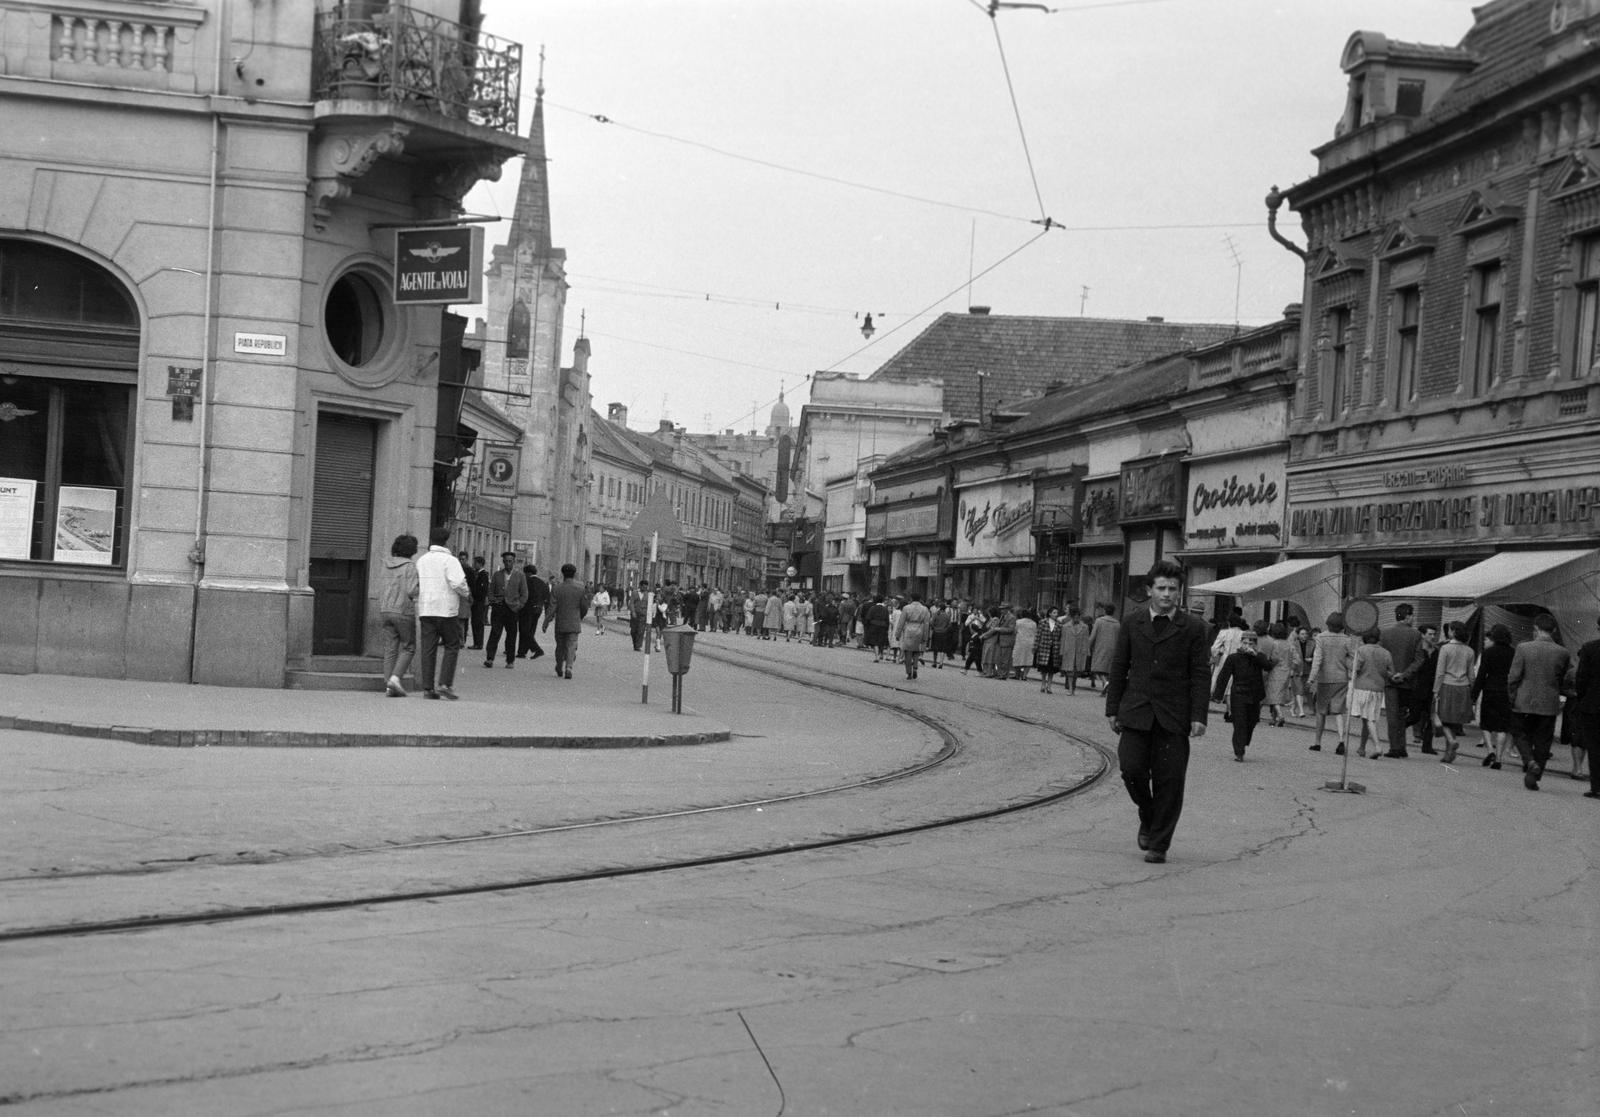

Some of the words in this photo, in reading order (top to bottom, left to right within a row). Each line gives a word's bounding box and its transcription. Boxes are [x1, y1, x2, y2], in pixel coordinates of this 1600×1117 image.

[441, 270, 468, 289] VOIAJ
[1193, 473, 1278, 517] Croitorie
[1377, 495, 1478, 532] PREZENTARE
